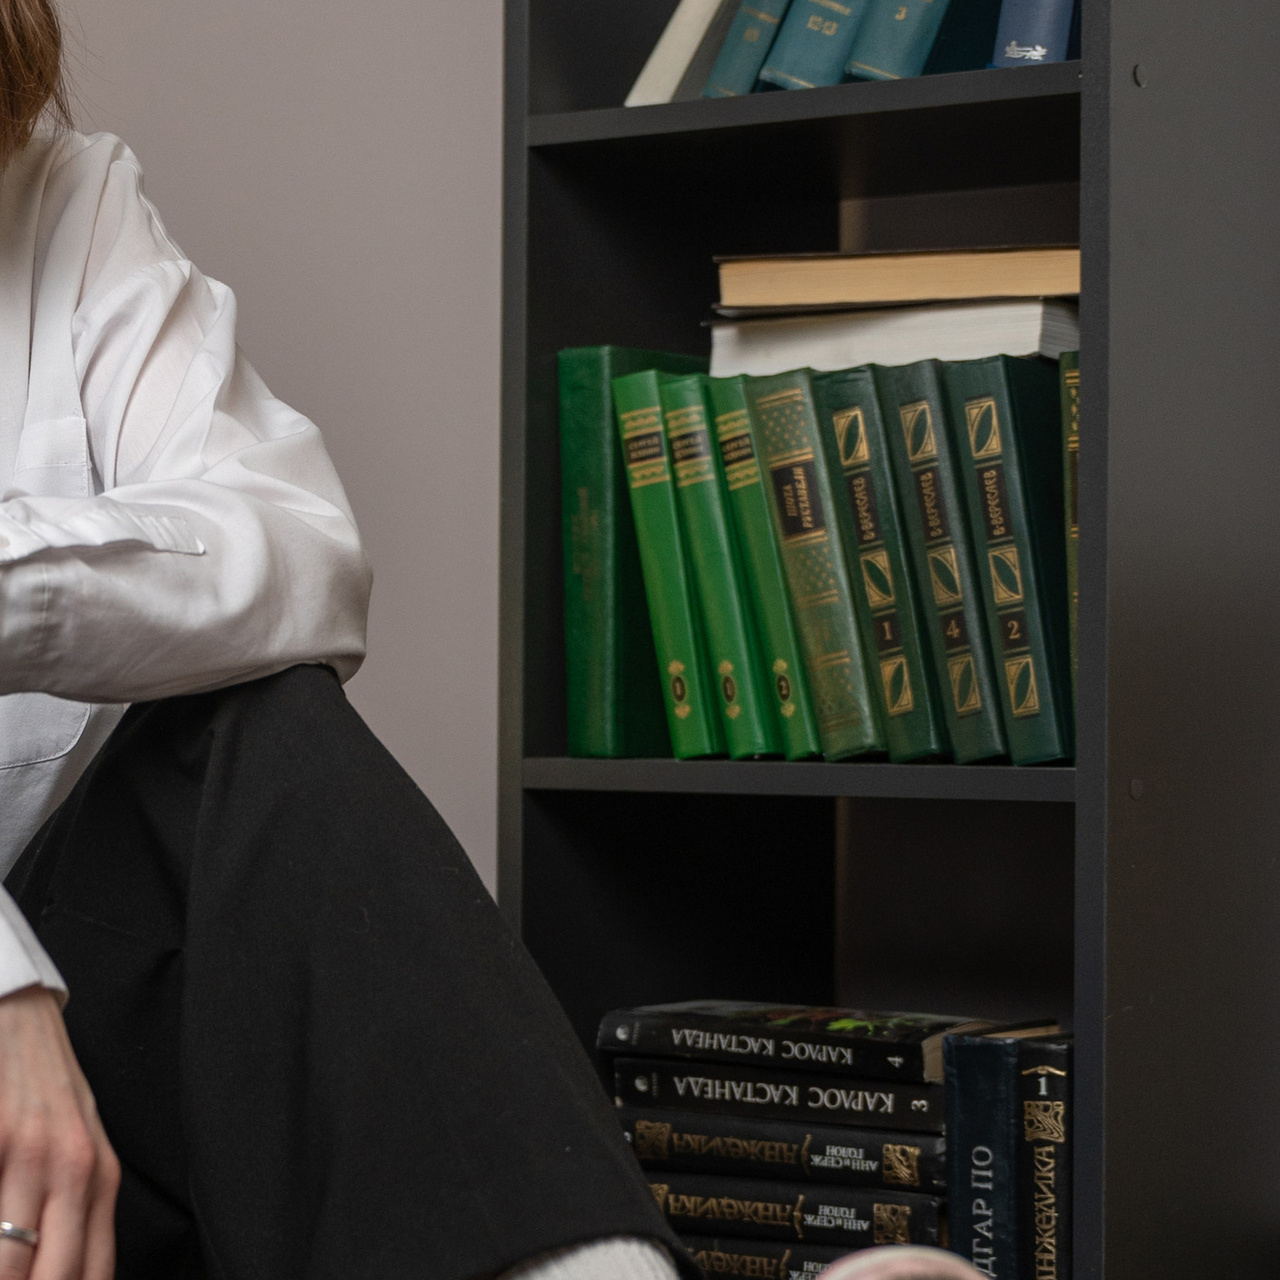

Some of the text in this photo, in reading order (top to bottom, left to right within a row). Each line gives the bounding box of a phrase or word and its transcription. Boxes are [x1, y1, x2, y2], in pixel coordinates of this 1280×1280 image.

[884, 622, 892, 640] 1
[946, 620, 959, 638] 4
[1008, 622, 1020, 640] 2
[671, 1028, 774, 1057] КАСТАНЕДА
[781, 1040, 853, 1065] КАРЛОС
[887, 1055, 904, 1068] 4
[673, 1076, 799, 1106] КАСТАНЕДА
[1037, 1076, 1047, 1095] 1
[808, 1087, 895, 1113] КАРЛОС
[911, 1099, 929, 1112] 3
[810, 1155, 843, 1168] СЕРЖ
[826, 1145, 865, 1160] ГОЛОН
[851, 1159, 879, 1172] АНН
[818, 1204, 856, 1218] ГОЛОН
[972, 1145, 997, 1278] ДГАР ПО
[804, 1214, 835, 1227] СЕРЖ
[843, 1218, 870, 1231] АНН
